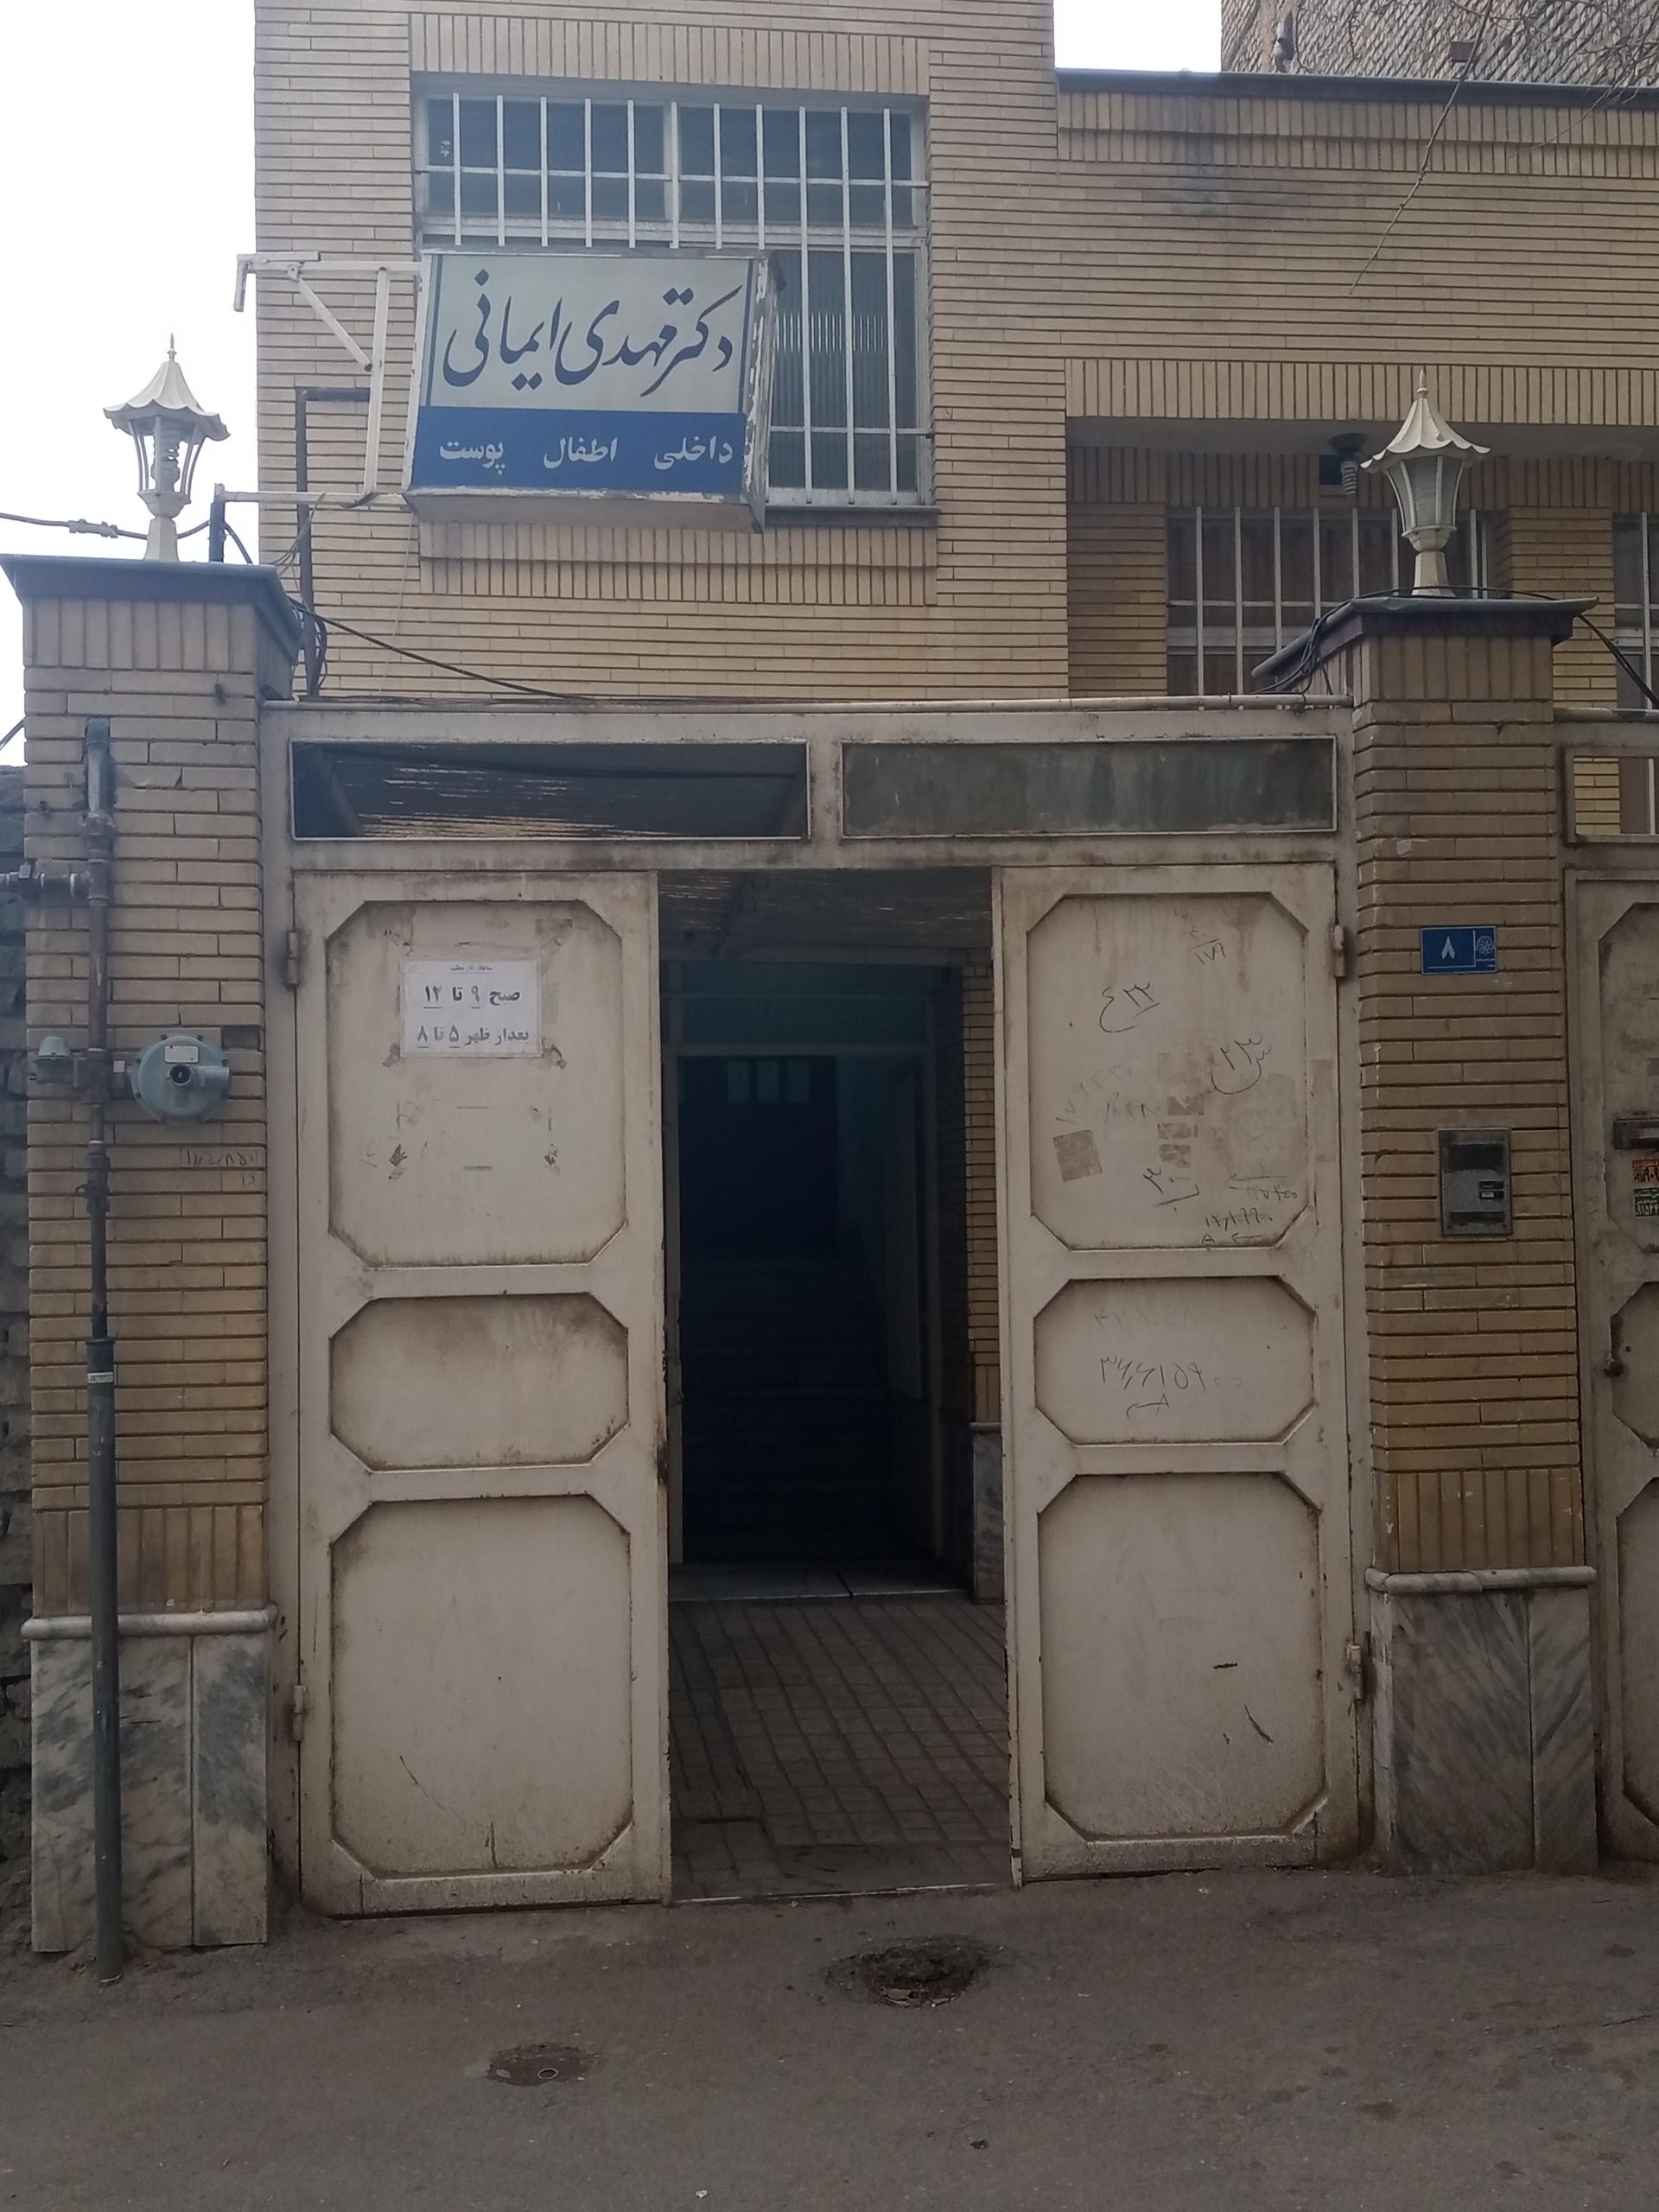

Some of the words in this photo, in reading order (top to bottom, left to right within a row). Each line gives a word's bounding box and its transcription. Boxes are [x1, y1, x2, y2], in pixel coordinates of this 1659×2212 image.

[442, 268, 563, 391] ایمانی
[554, 299, 678, 386] مهدی
[639, 283, 743, 397] دکتر
[438, 438, 505, 476] پوست
[543, 435, 619, 469] اطفال
[653, 435, 734, 470] داخلی
[1440, 935, 1457, 960] ۸
[424, 984, 442, 1003] ۱۲
[452, 986, 463, 1001] تا
[471, 985, 480, 1002] ۹
[489, 990, 521, 1006] صبح
[416, 1025, 429, 1043] ۸
[434, 1026, 444, 1041] تا
[448, 1025, 460, 1042] ۵
[464, 1027, 491, 1046] ظهر
